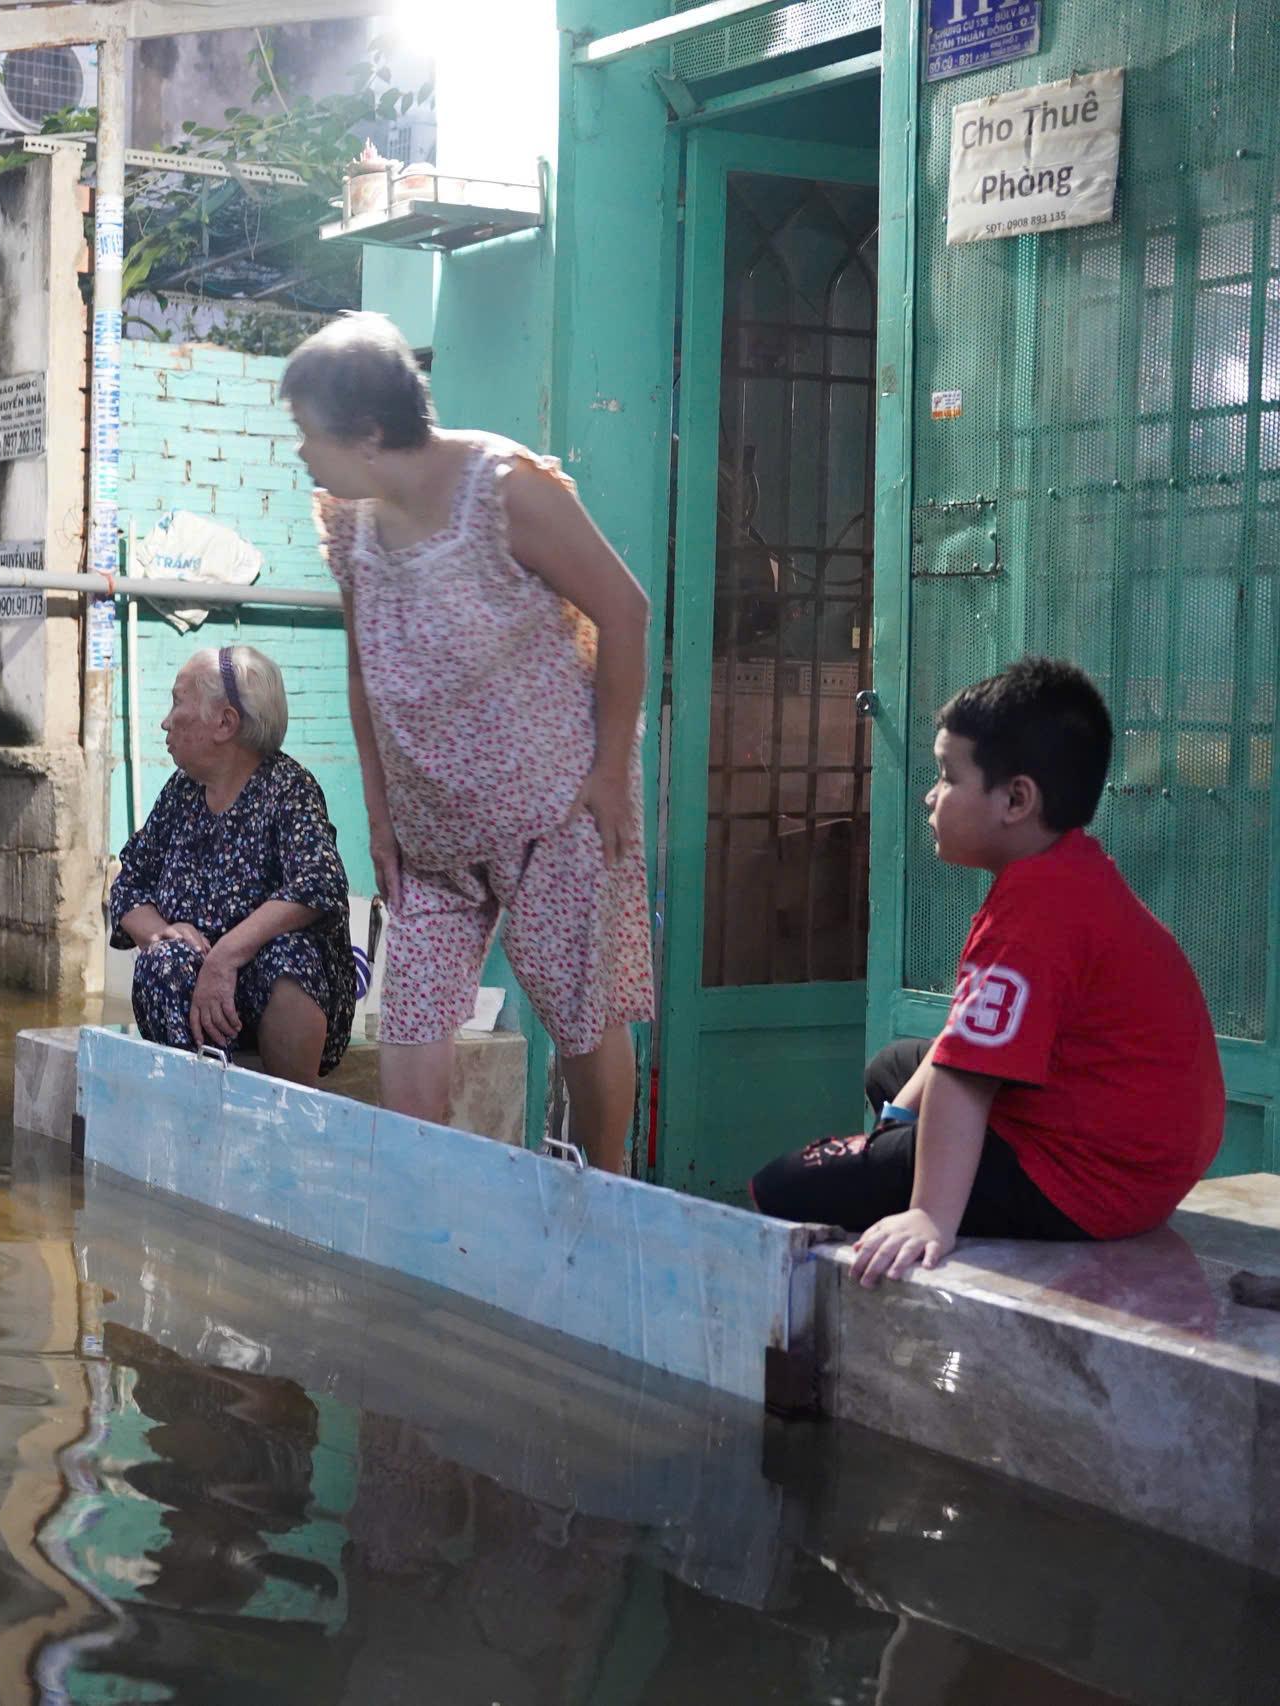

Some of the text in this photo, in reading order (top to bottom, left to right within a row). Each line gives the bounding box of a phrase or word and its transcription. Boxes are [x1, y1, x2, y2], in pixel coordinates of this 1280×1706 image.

[962, 90, 1099, 149] Cho Thuê
[981, 165, 1074, 205] Phòng
[1007, 215, 1029, 230] 0908
[1030, 213, 1048, 225] 893
[1050, 210, 1067, 223] 135
